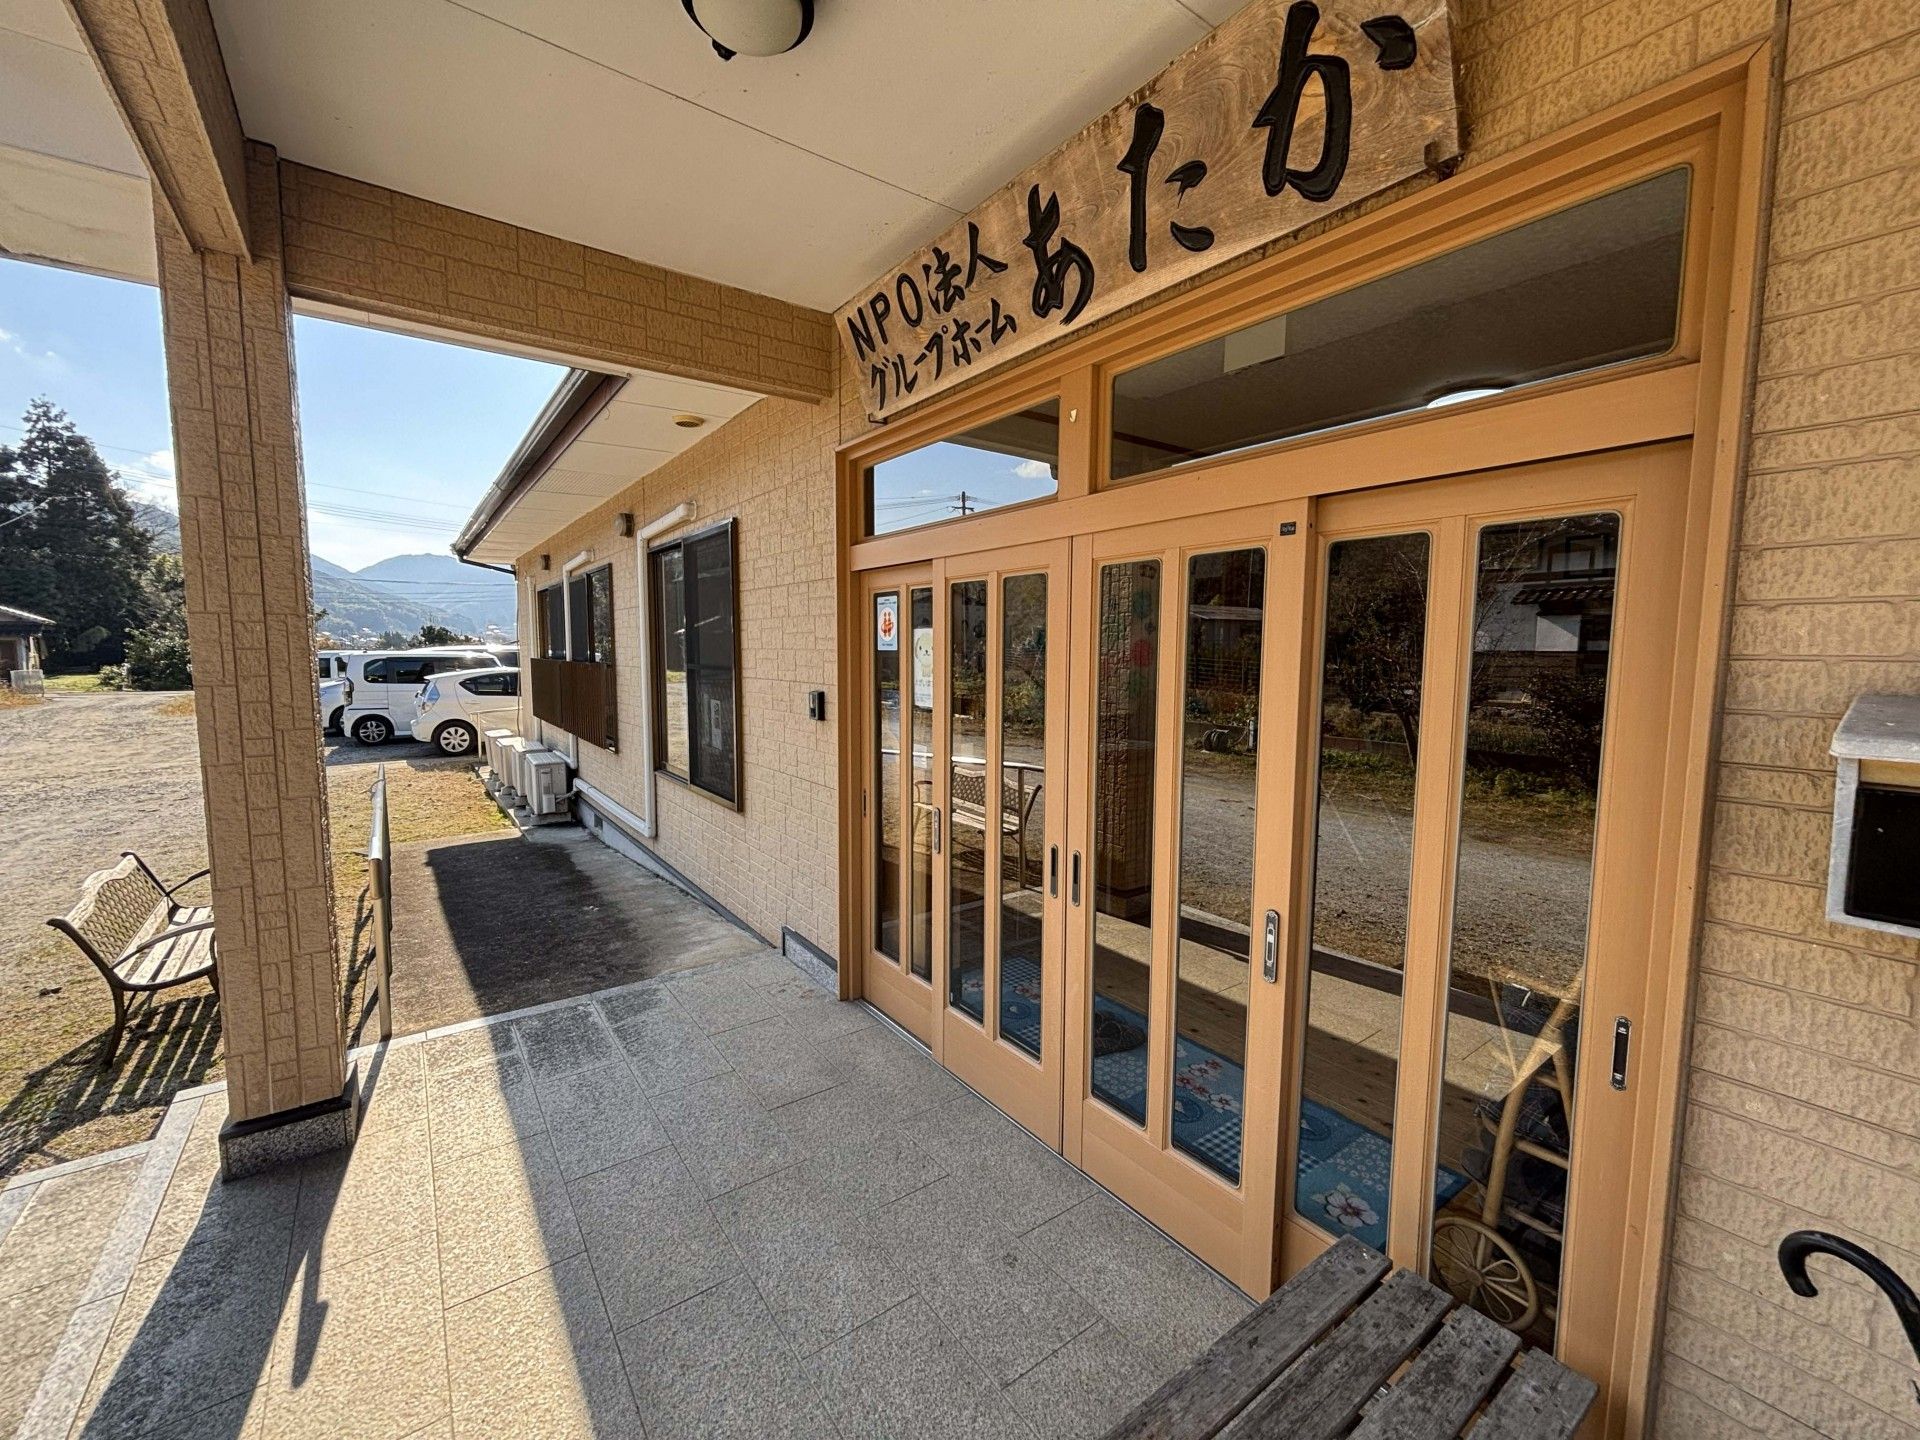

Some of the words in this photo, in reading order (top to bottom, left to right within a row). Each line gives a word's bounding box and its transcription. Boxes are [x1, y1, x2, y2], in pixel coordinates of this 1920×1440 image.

[1022, 1, 1417, 326] あたか
[847, 221, 1008, 361] NPO法人
[871, 297, 1017, 411] グループホーム
